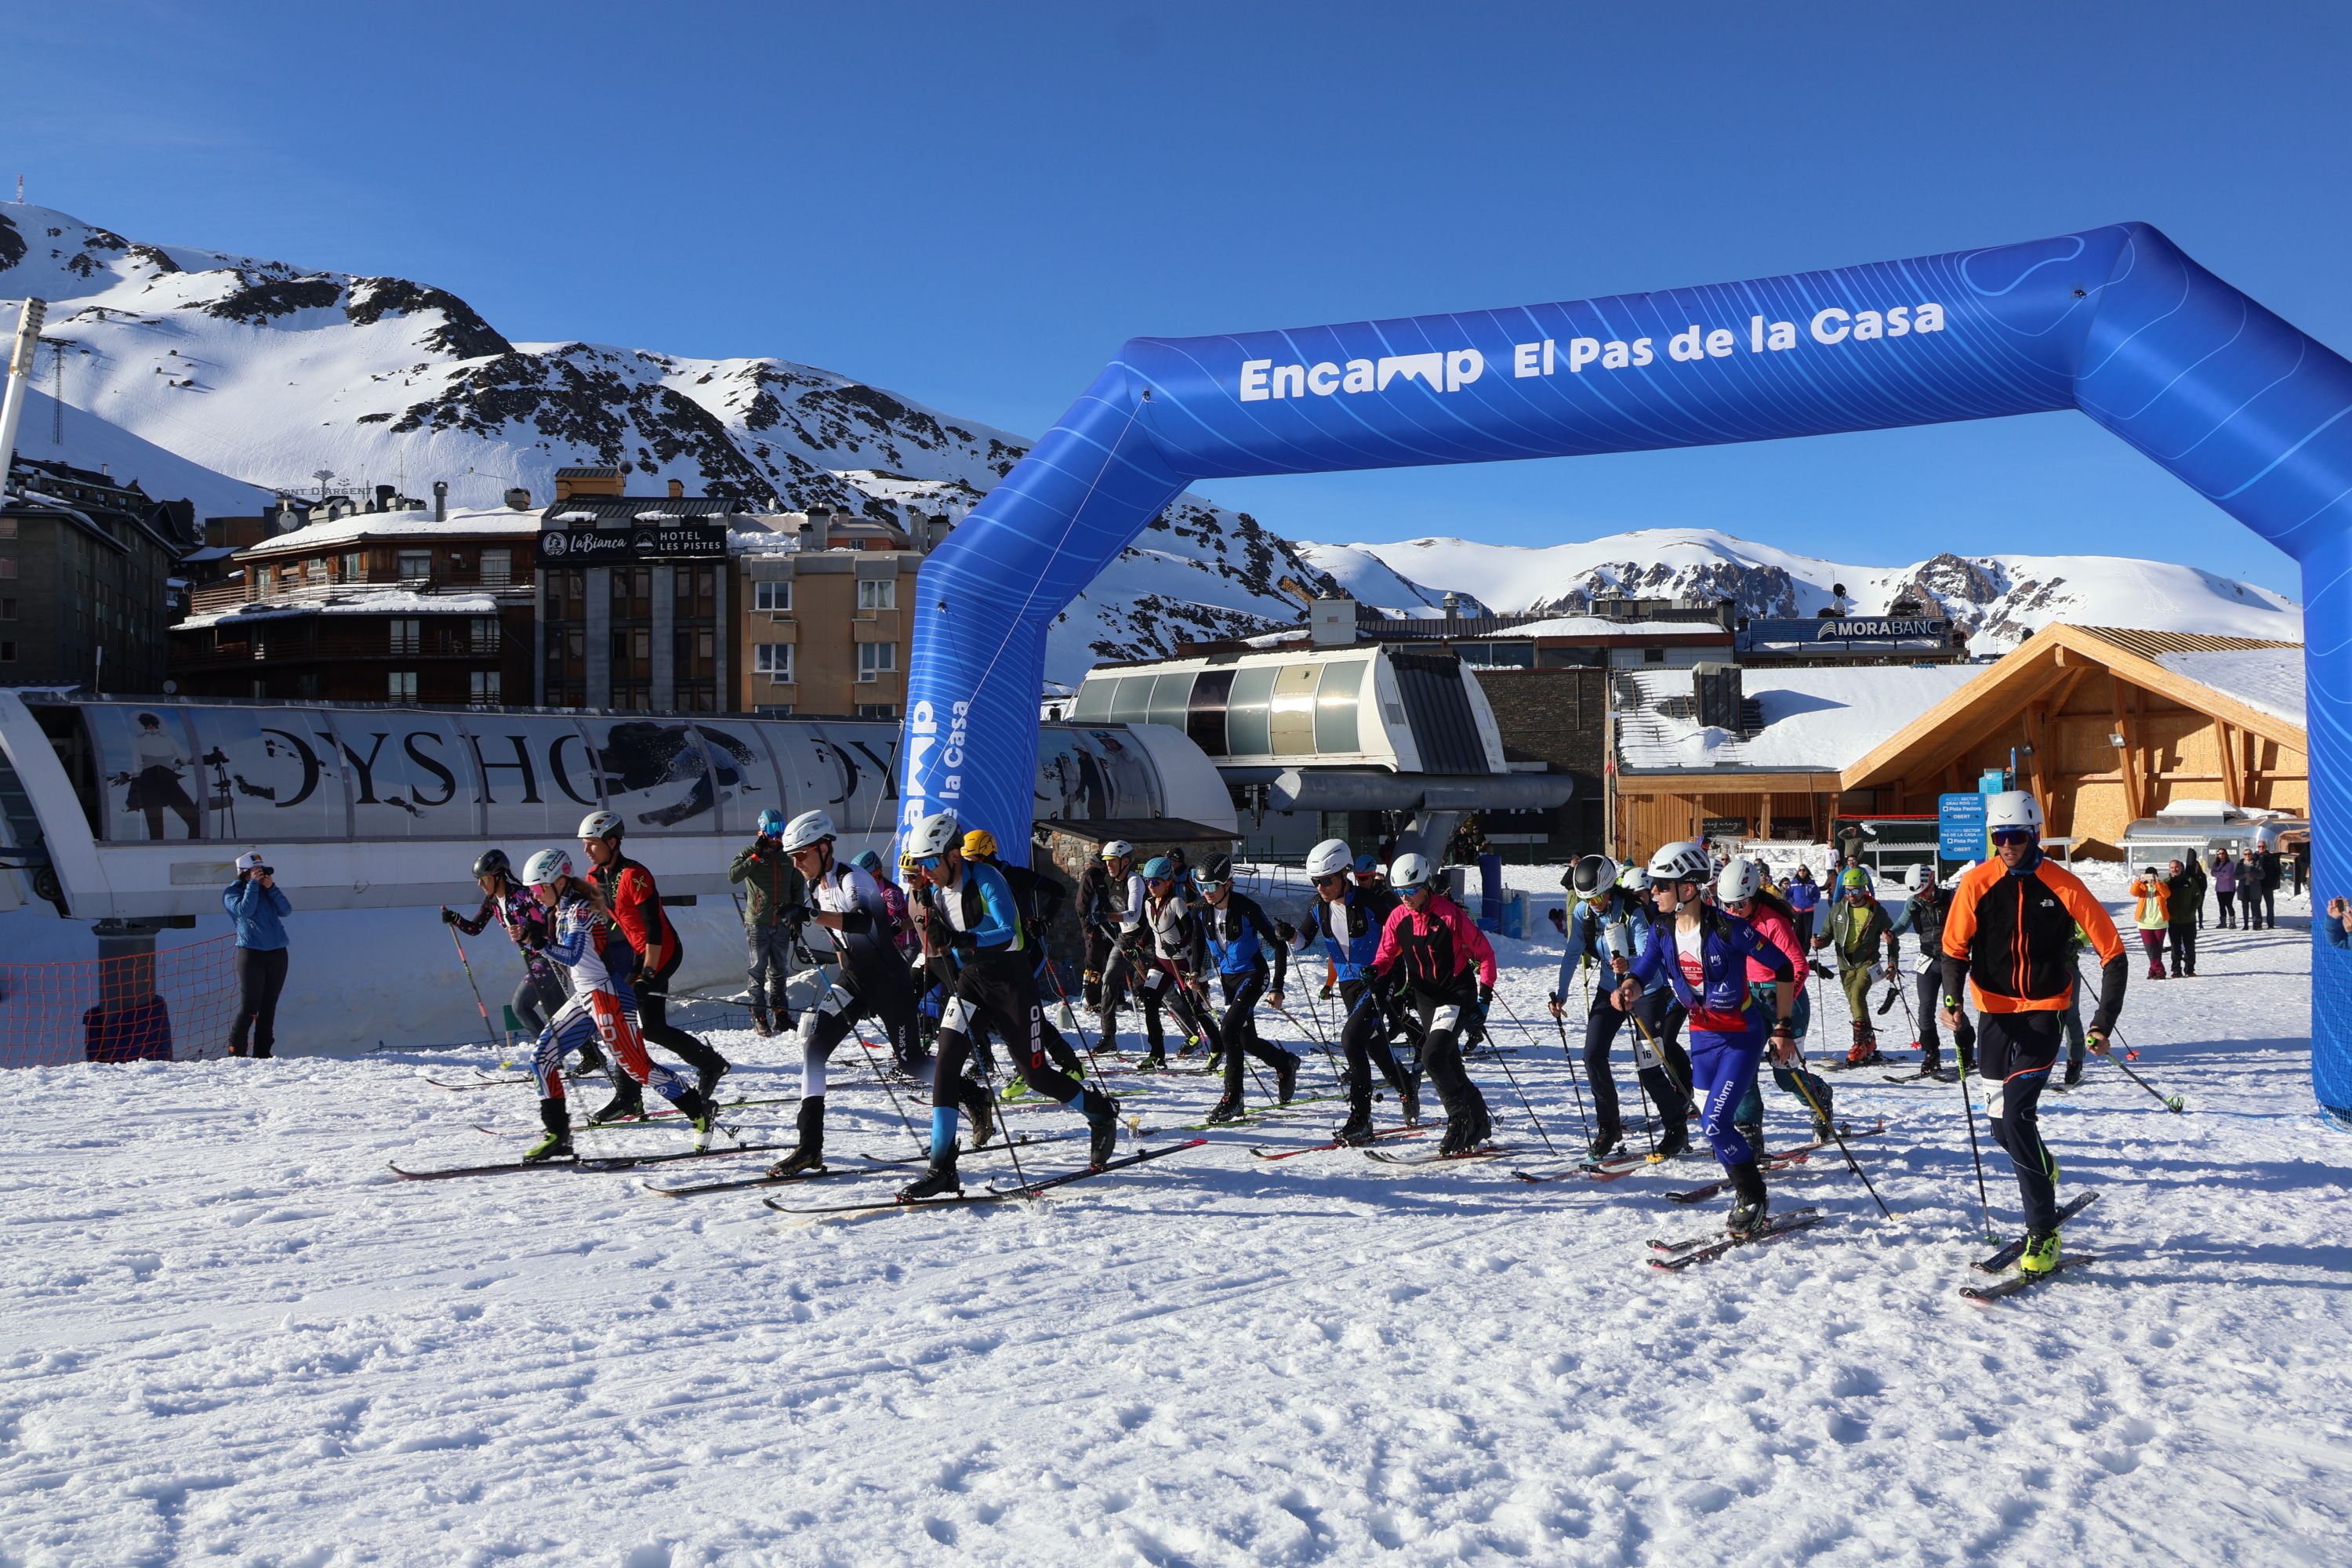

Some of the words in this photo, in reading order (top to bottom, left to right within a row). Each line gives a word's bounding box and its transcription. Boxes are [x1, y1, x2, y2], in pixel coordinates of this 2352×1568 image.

[1240, 348, 1484, 402] Encamp
[1514, 339, 1555, 379] El
[1570, 337, 1654, 373] Pas
[1668, 325, 1734, 362] de
[1751, 314, 1797, 353] la
[1809, 302, 1945, 345] Casa
[659, 531, 701, 541] HOTEL
[683, 541, 720, 550] PISTES
[1838, 620, 1939, 636] MORABANC
[943, 701, 969, 768] Casa
[1641, 1049, 1652, 1059] 16
[1708, 1080, 1734, 1123] Andorra
